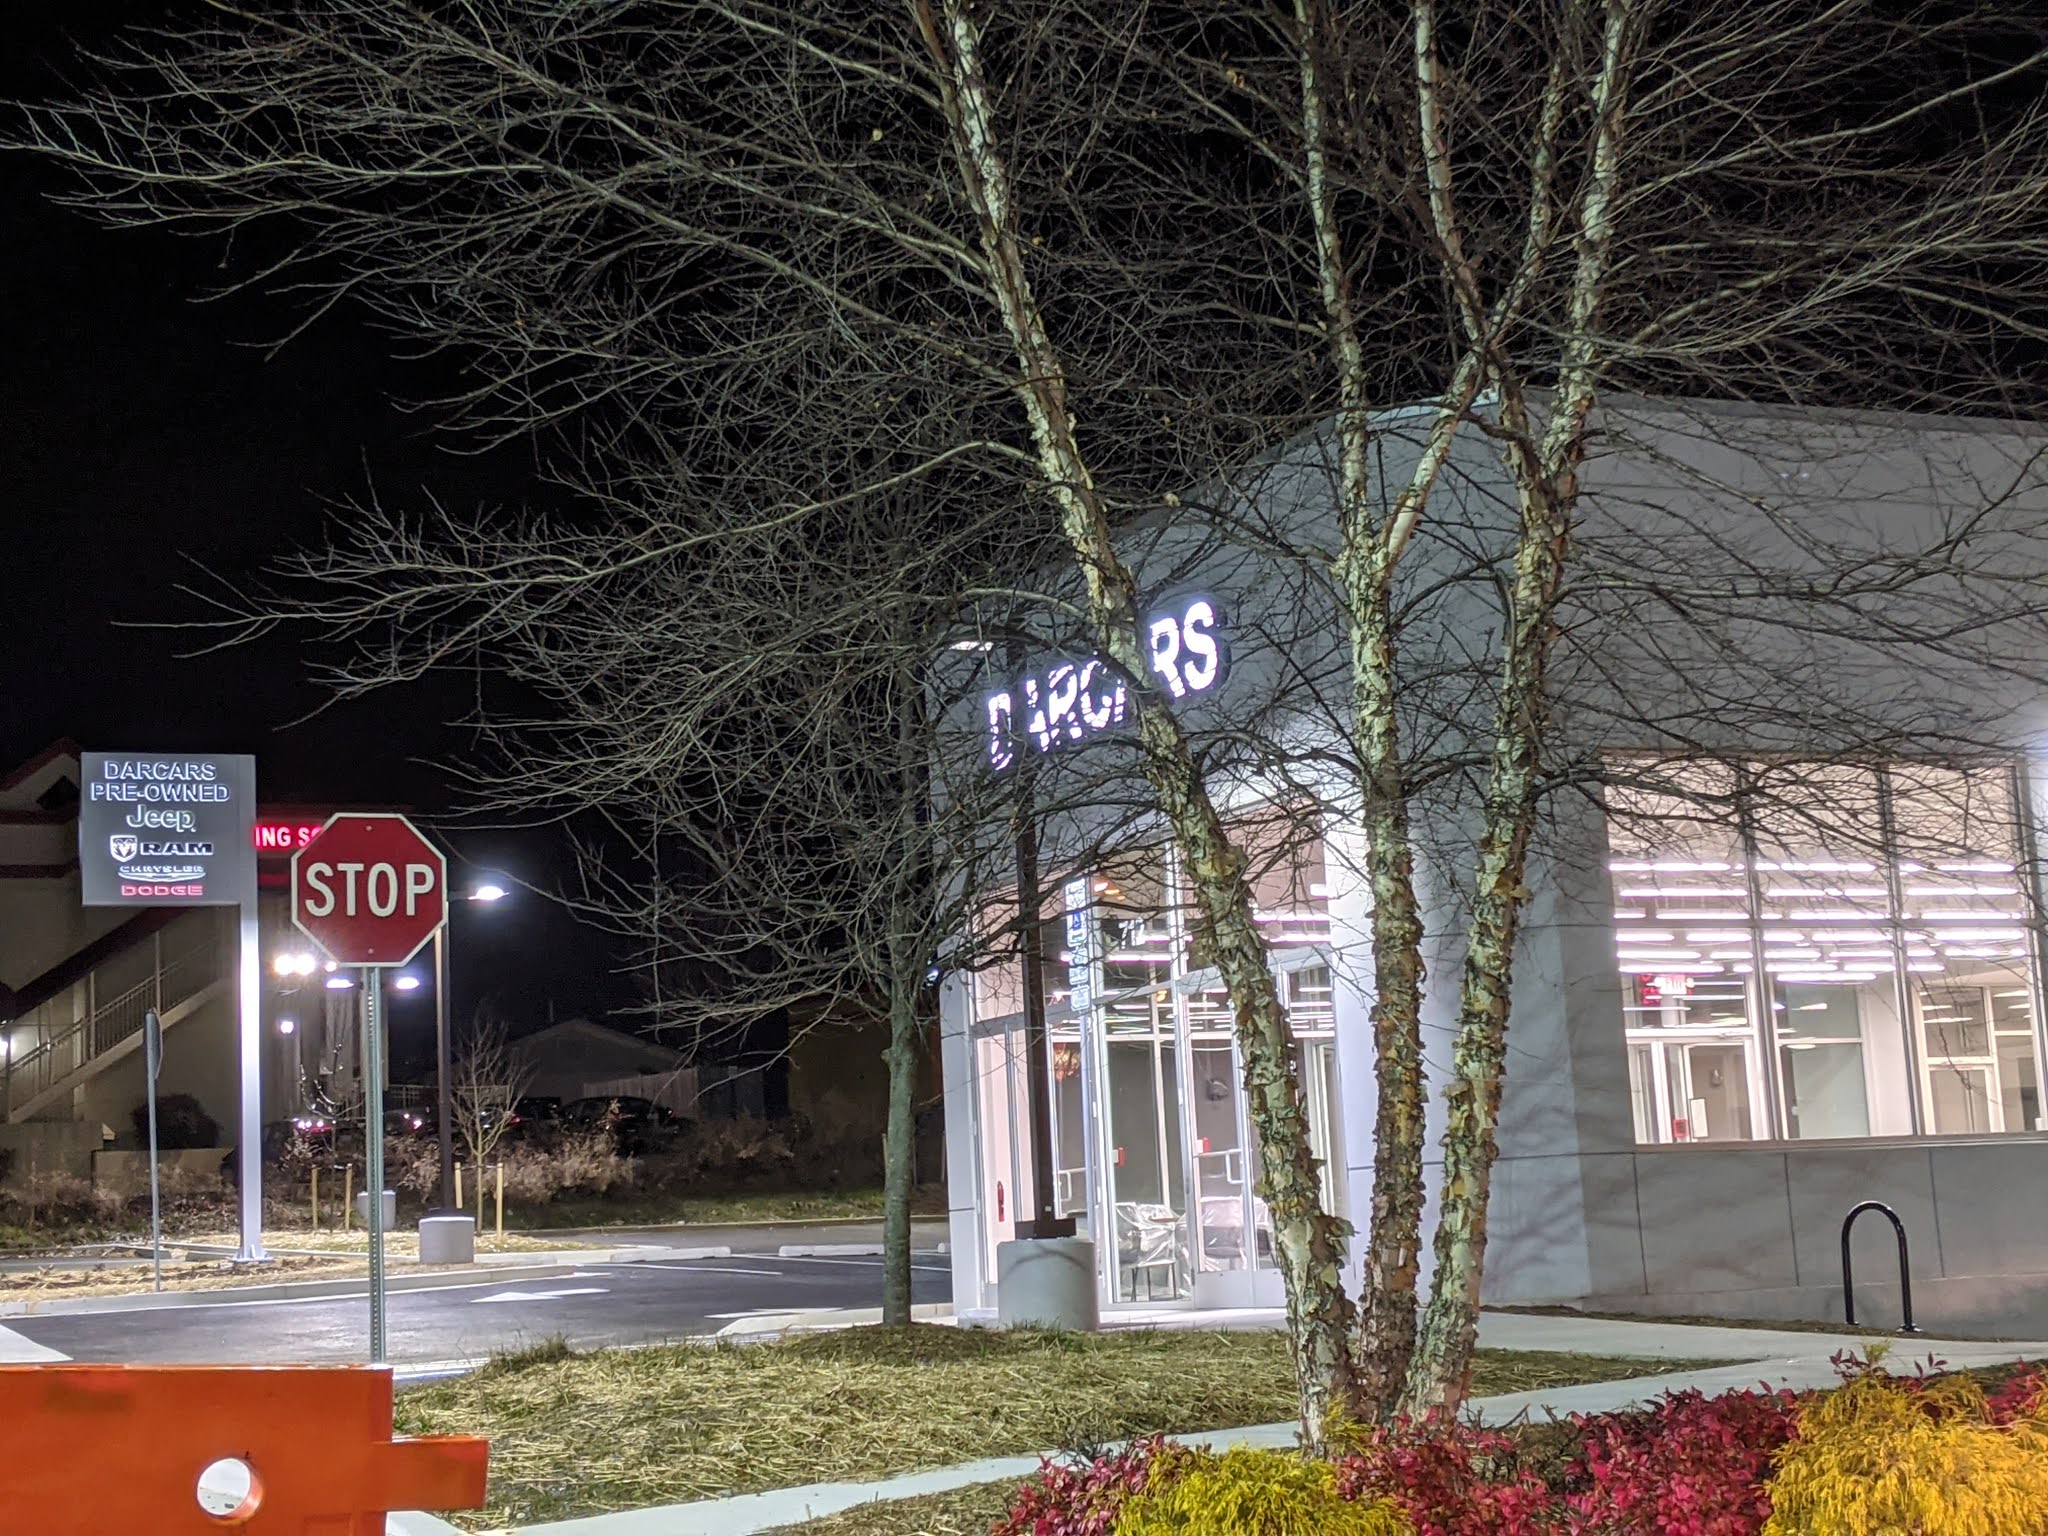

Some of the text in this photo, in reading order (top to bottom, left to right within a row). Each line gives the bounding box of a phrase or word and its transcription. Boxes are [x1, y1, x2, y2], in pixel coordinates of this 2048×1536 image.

[104, 760, 217, 780] DARCARS
[90, 782, 230, 802] PRE-OWNED
[126, 804, 196, 832] Jeep
[140, 842, 214, 856] RAM
[119, 865, 205, 873] CHRYSLER
[121, 884, 204, 896] DODGE
[304, 862, 435, 918] STOP
